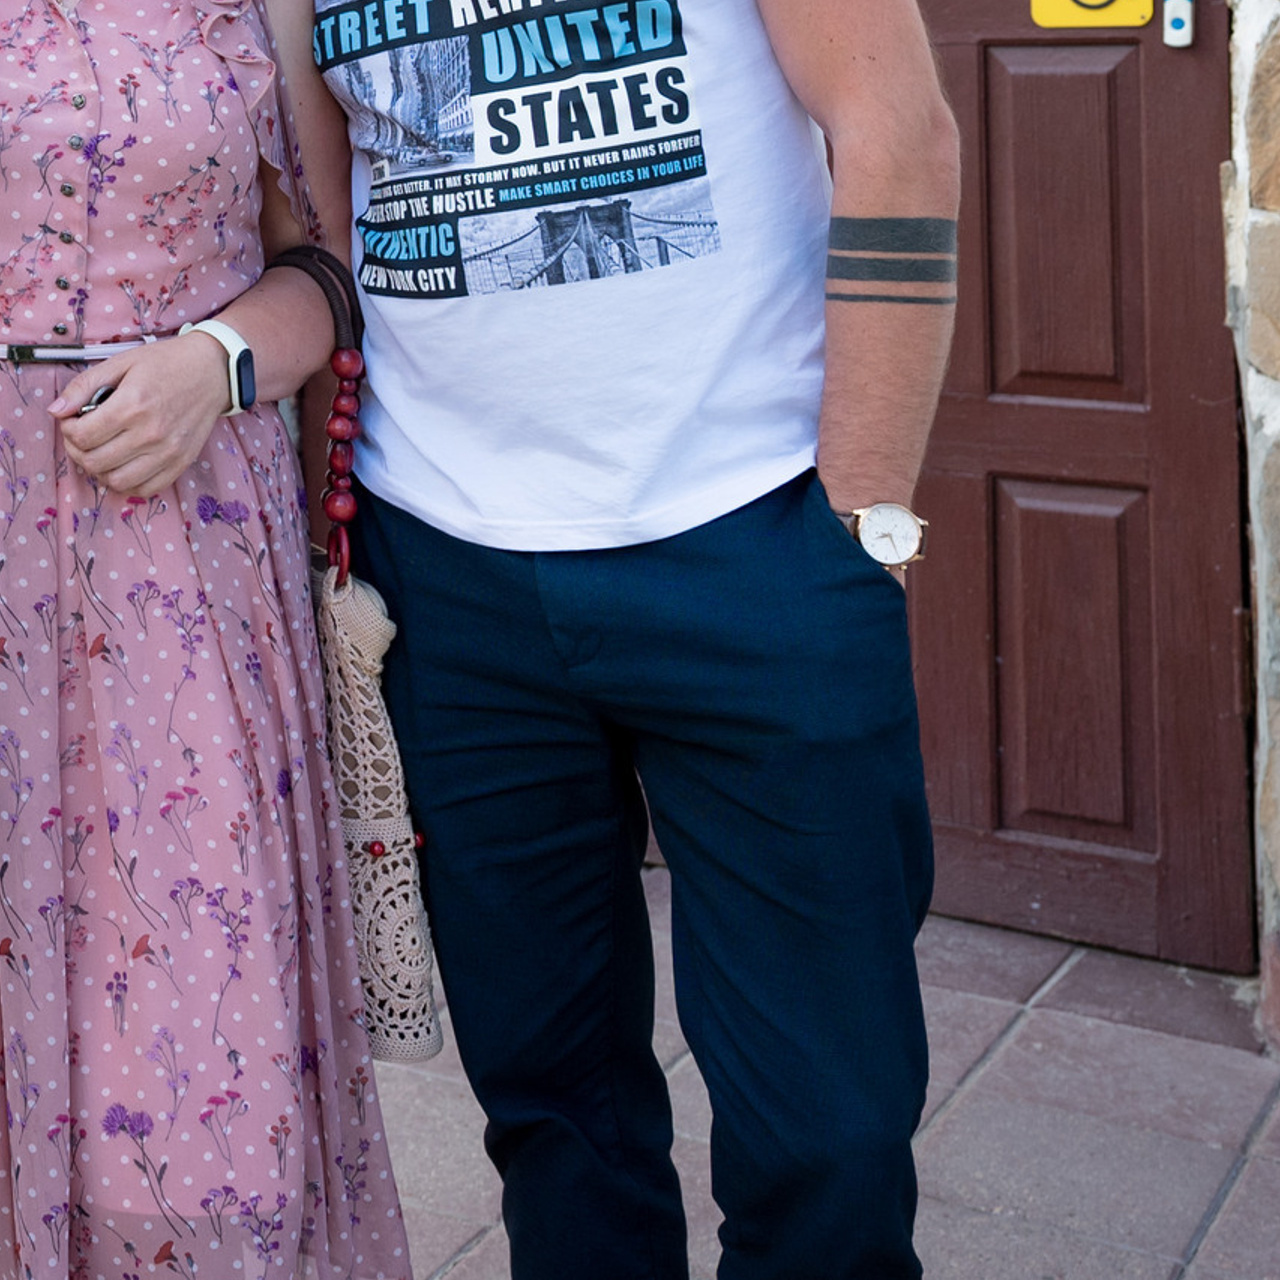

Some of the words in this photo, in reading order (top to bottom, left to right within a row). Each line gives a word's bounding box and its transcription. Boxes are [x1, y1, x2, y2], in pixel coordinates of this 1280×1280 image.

[486, 66, 690, 155] STATES
[407, 196, 430, 218] THE
[433, 187, 496, 215] HUSTLE
[498, 185, 532, 202] MAKE
[534, 178, 577, 197] SMART
[580, 169, 635, 190] CHOICES
[637, 166, 650, 181] IN
[652, 160, 682, 178] YOUR
[683, 154, 704, 171] LIFE
[434, 178, 444, 190] IT
[464, 168, 509, 186] STORMY
[511, 163, 541, 179] NOW.
[543, 159, 566, 174] BUT
[568, 157, 580, 170] IT
[583, 150, 620, 168] NEVER
[621, 144, 657, 161] RAINS
[657, 135, 701, 155] FOREVER
[361, 263, 388, 288] NEW
[386, 268, 419, 292] YORK
[417, 266, 456, 292] CITY
